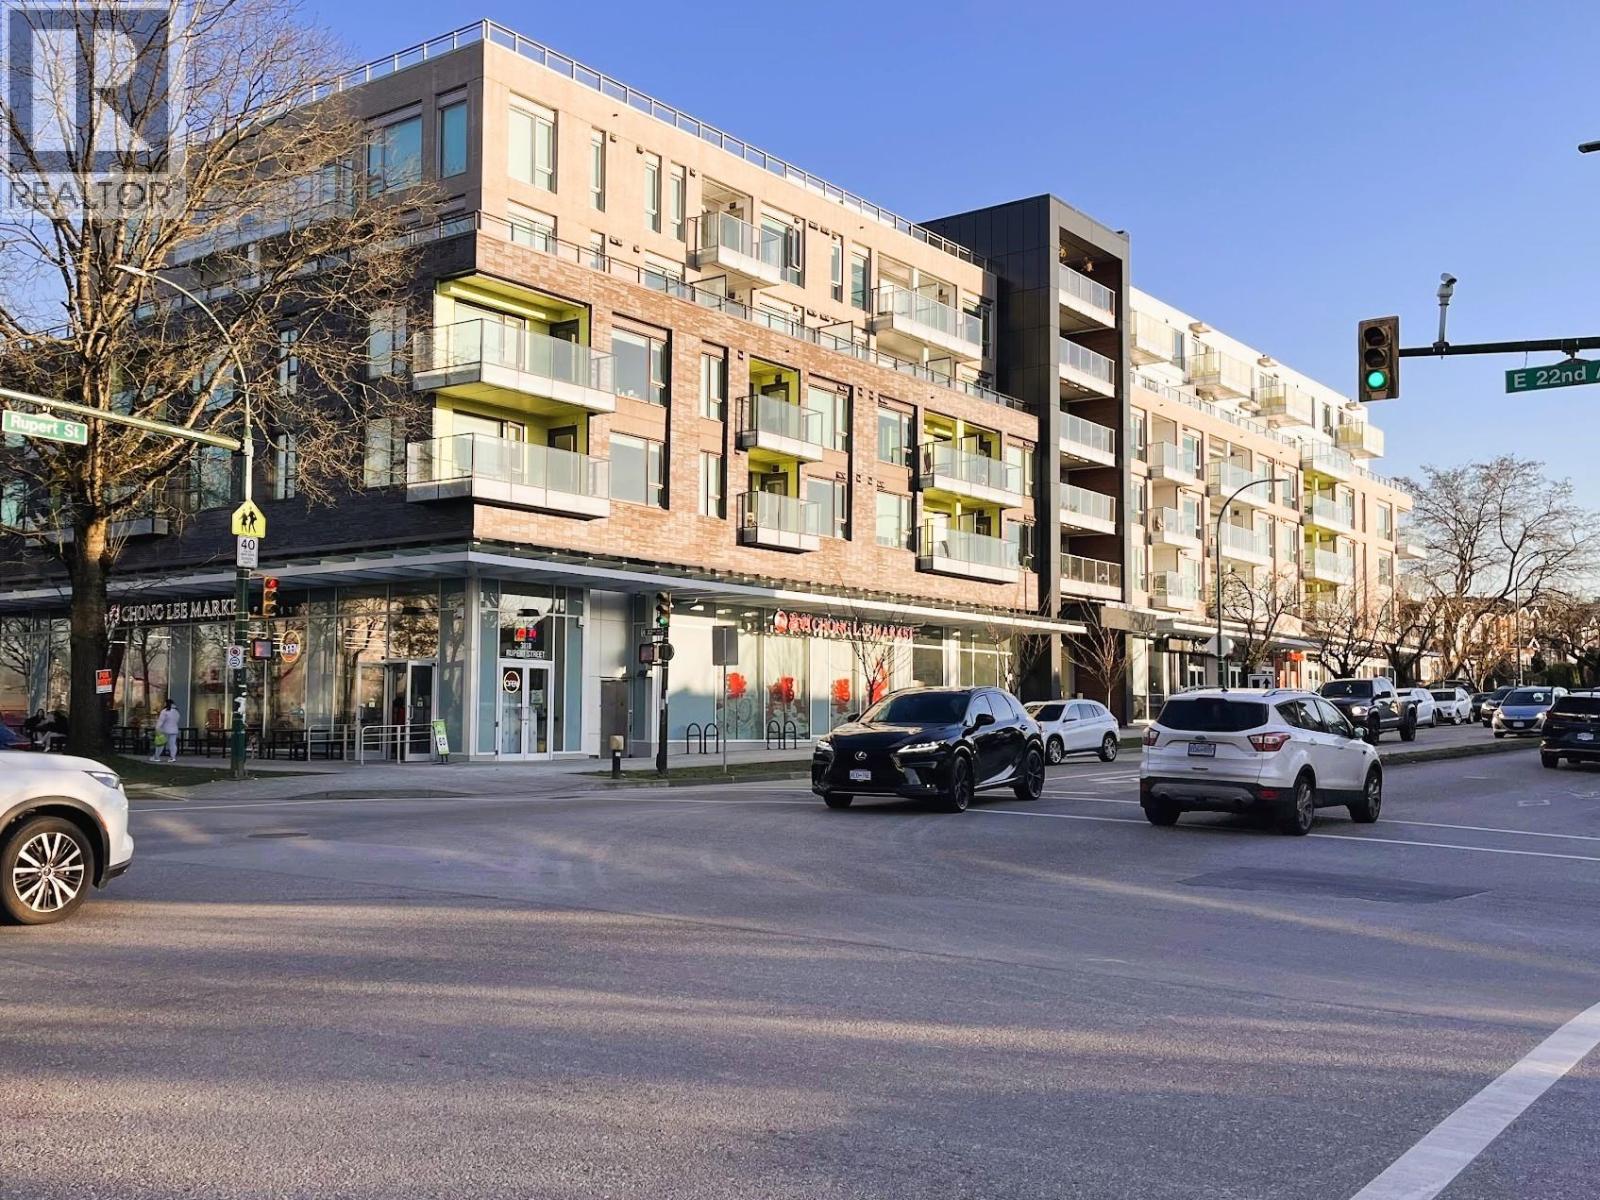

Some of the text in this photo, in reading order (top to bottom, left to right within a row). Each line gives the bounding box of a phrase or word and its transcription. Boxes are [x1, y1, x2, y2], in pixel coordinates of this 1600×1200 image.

[1514, 373, 1526, 388] E
[1536, 365, 1587, 387] 22nd
[11, 414, 79, 438] Rupert St
[241, 539, 256, 551] 40
[121, 604, 164, 622] CHONG
[166, 602, 188, 620] LEE
[190, 599, 237, 618] MARKE
[526, 650, 545, 659] STREET
